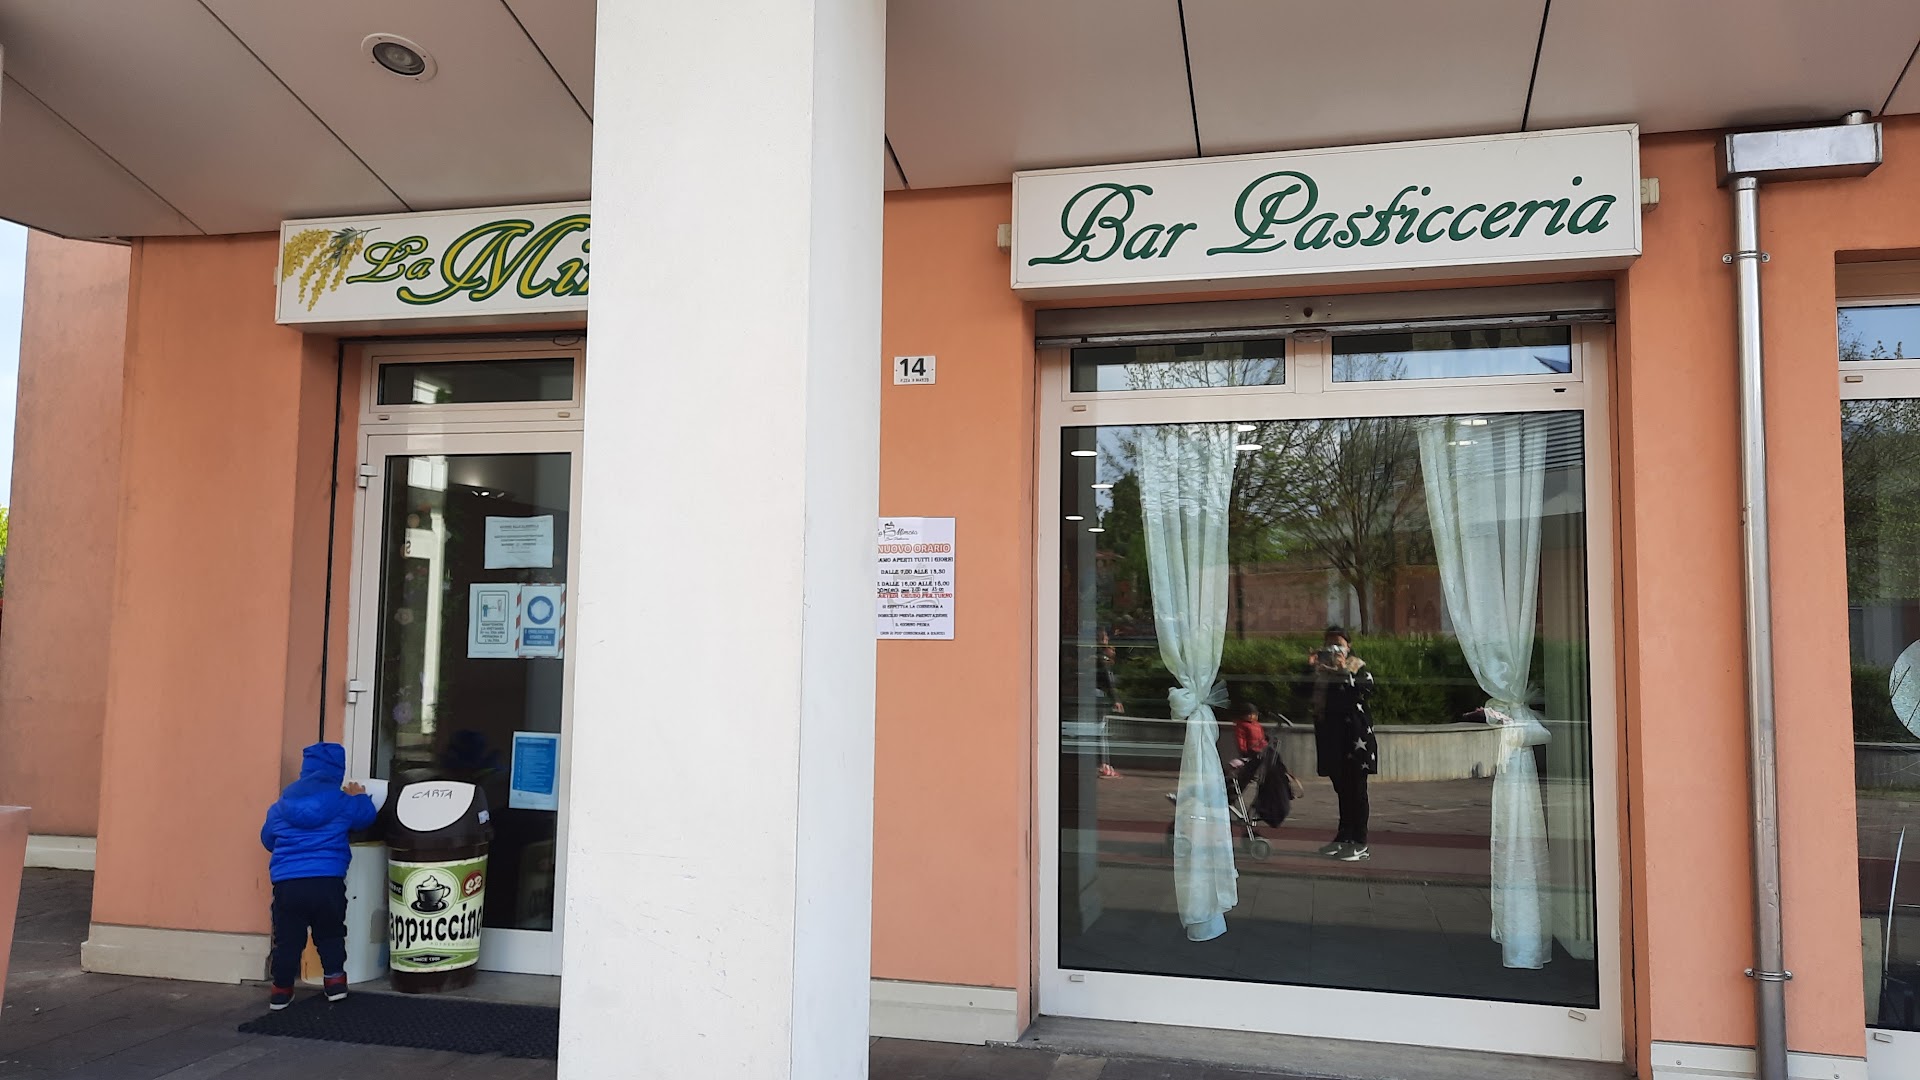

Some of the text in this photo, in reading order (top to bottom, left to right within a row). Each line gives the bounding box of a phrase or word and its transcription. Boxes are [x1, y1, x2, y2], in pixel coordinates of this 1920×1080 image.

[1028, 170, 1617, 266] Bar Pasticceria
[346, 236, 434, 284] La
[899, 358, 926, 377] 14
[878, 543, 951, 554] NUOVO ORARIO
[412, 789, 453, 799] CARTA
